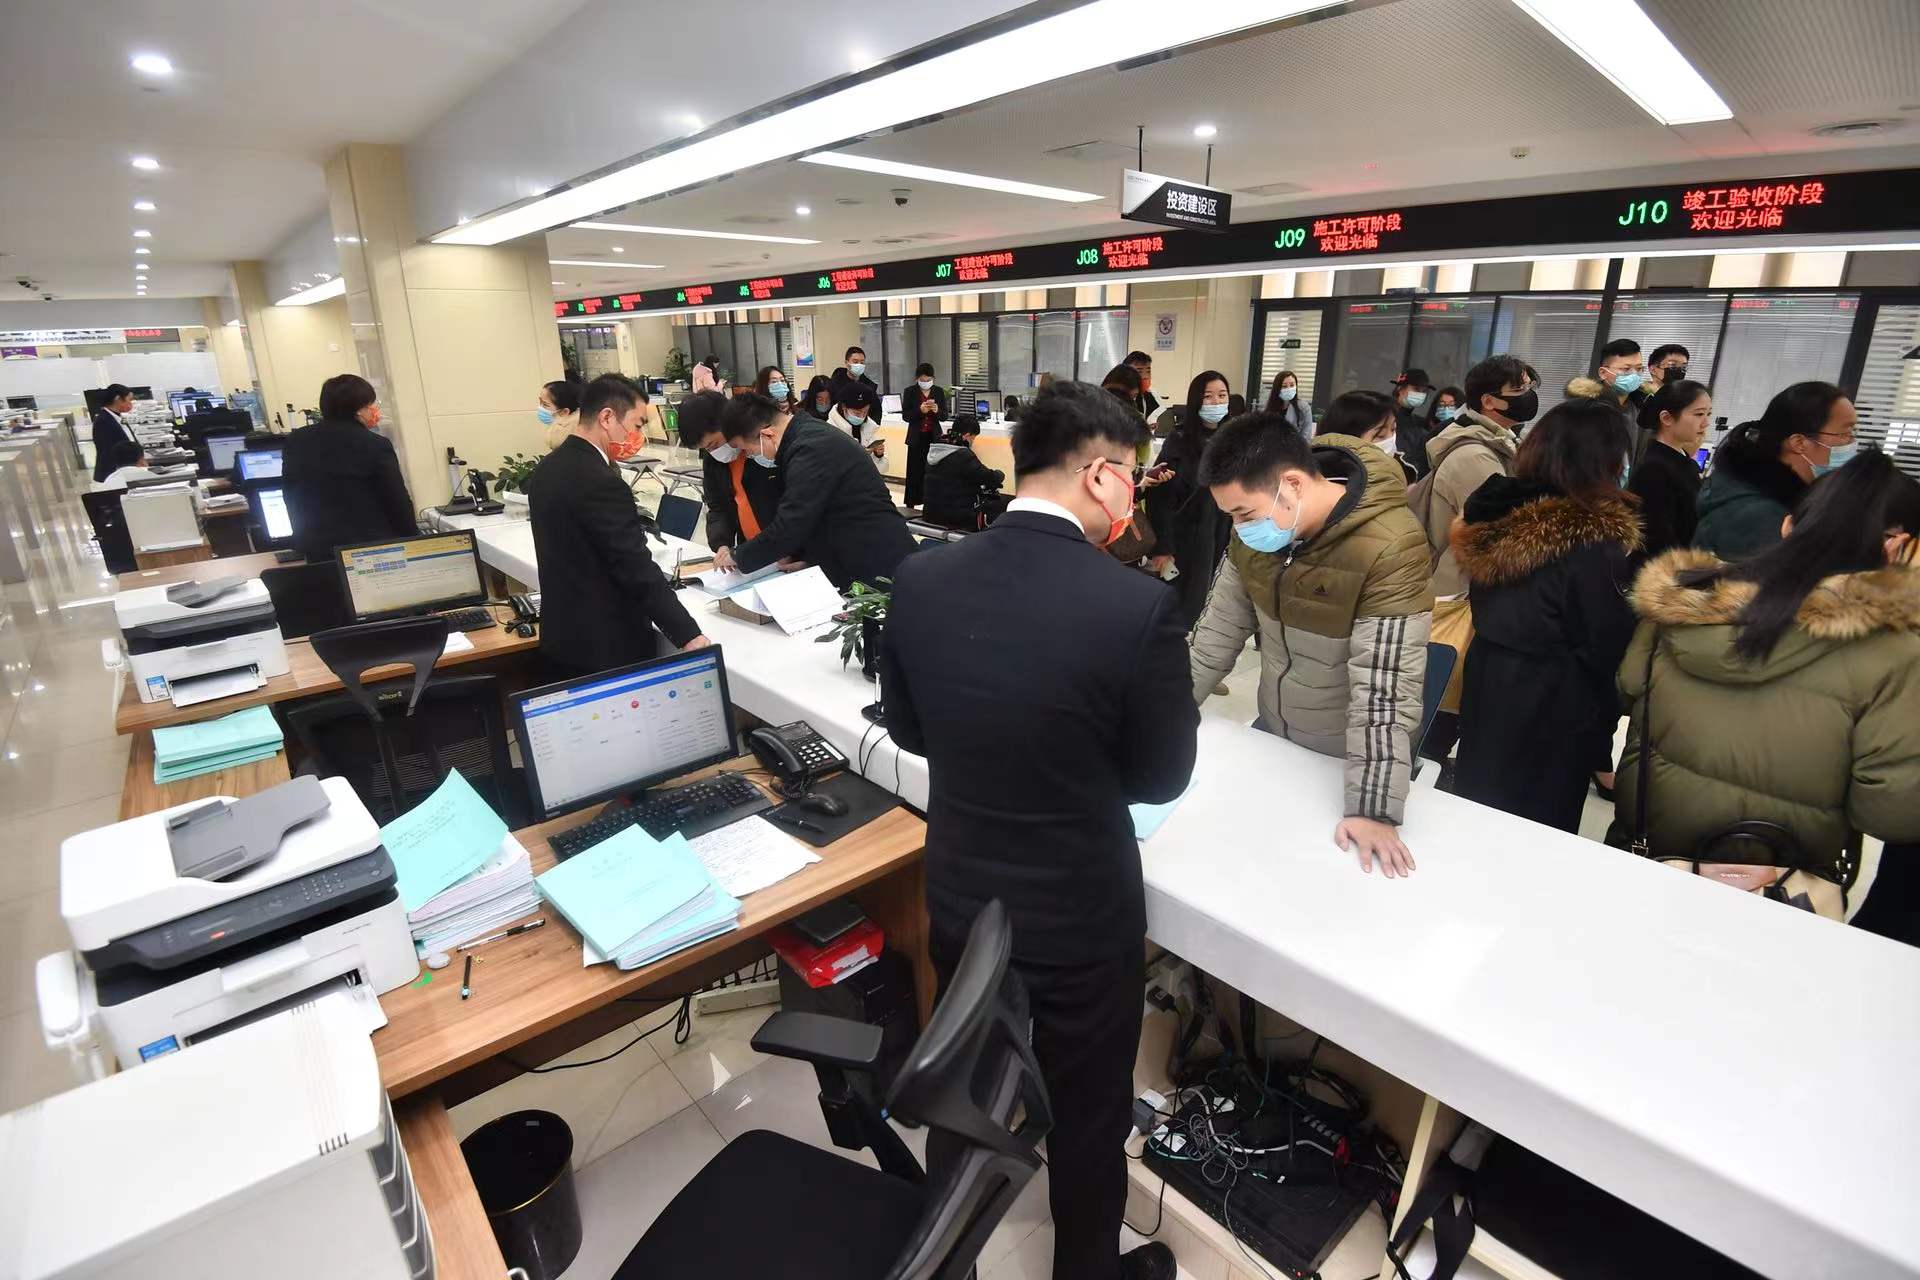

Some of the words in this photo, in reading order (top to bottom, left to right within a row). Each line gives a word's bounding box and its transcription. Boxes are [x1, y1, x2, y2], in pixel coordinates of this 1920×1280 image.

[1166, 189, 1217, 216] 投资建设区
[1683, 182, 1825, 211] 竣工验收阶段
[1618, 200, 1669, 226] J10
[1690, 207, 1783, 231] 欢迎光临
[1313, 213, 1401, 237] 施工许可阶段
[1102, 237, 1163, 255] 施工许可阶段
[1275, 228, 1306, 248] J09
[1320, 233, 1378, 252] 欢迎光临
[954, 252, 1013, 270] 工程建设许可阶段
[1077, 248, 1099, 265] J08
[1108, 253, 1148, 268] 欢迎光临
[936, 263, 951, 277] J07
[817, 276, 831, 288] J06
